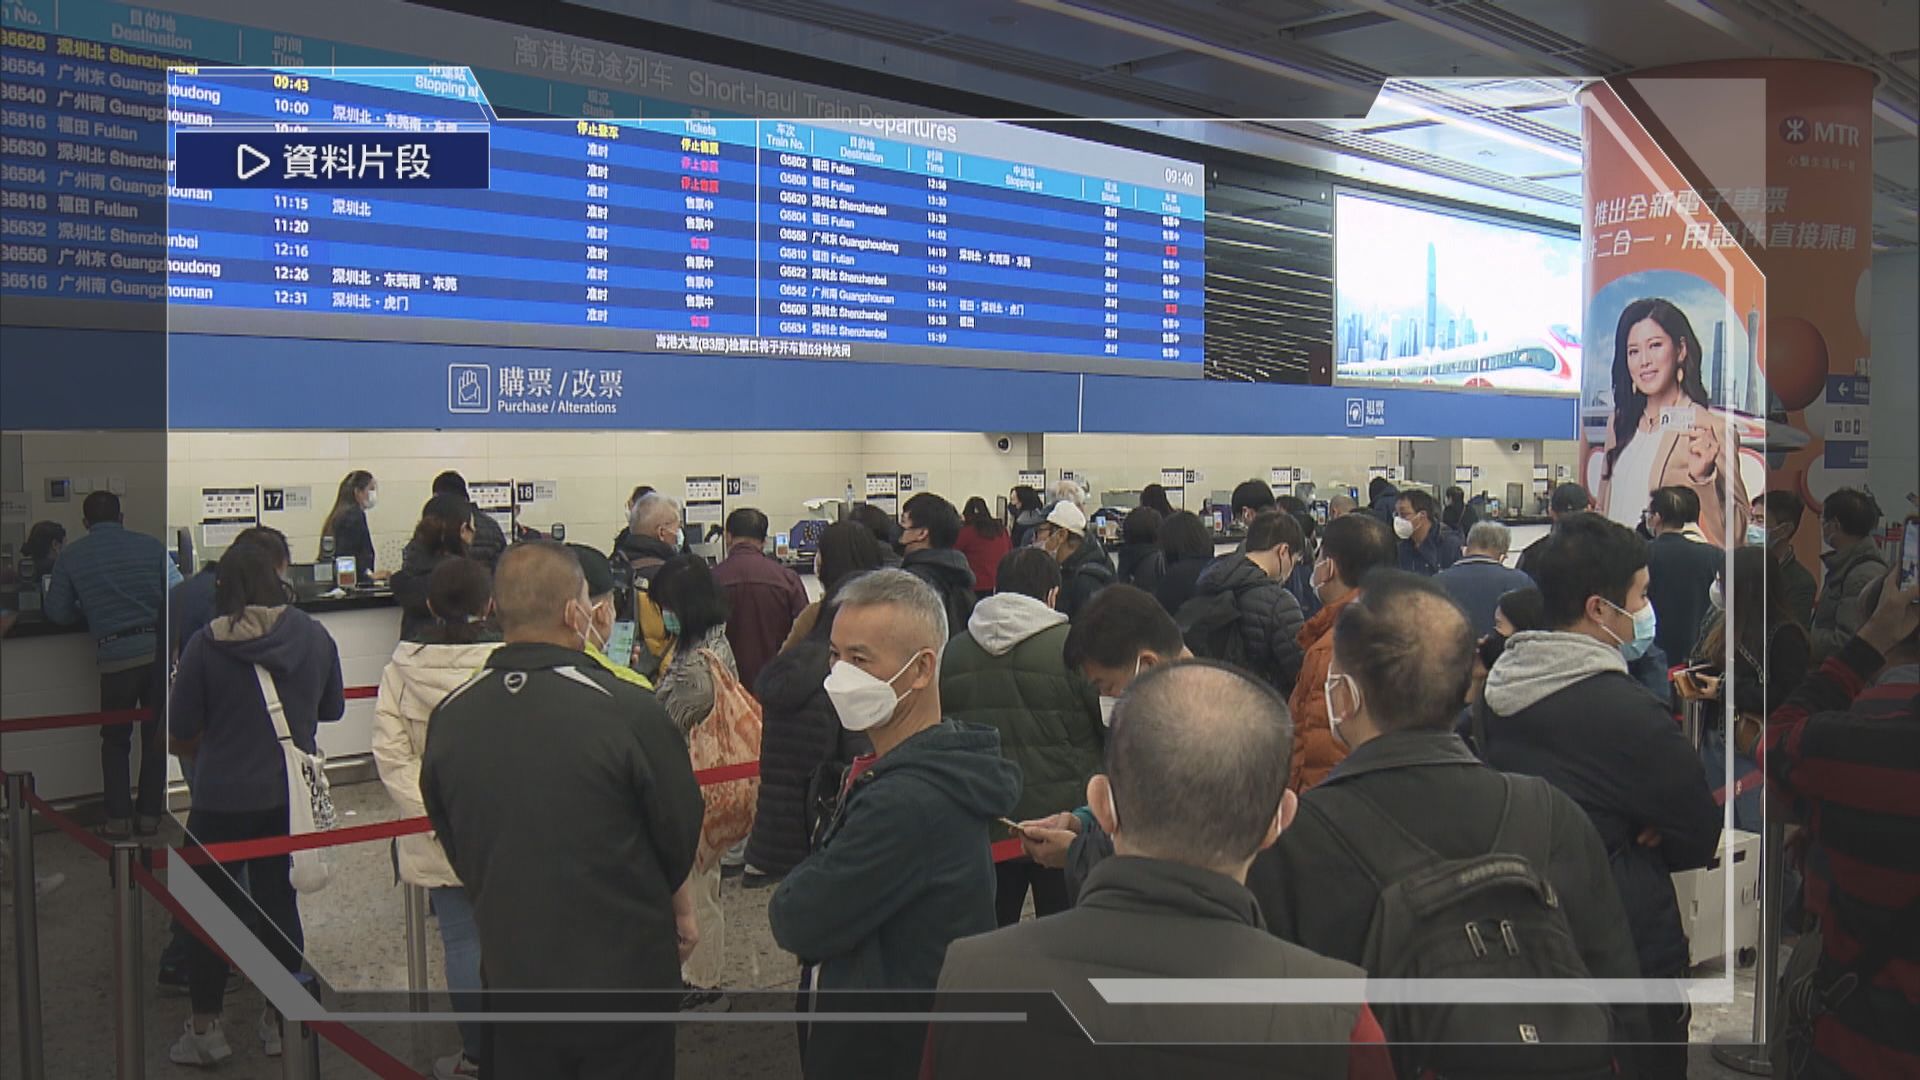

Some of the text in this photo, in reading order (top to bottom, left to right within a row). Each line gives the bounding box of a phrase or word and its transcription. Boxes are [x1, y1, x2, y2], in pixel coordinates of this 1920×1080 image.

[57, 38, 105, 60] 深圳北
[274, 75, 309, 93] 09:43
[57, 64, 106, 86] 广州东
[109, 73, 220, 105] Guangzhoudong
[275, 98, 309, 115] 10:00
[513, 33, 959, 142] 离港短途列车 Short-haul Train Departures
[109, 98, 213, 127] Guangzhounan
[1814, 121, 1859, 148] MTR
[57, 142, 105, 163] 深圳北
[1164, 167, 1194, 187] 09:40
[274, 195, 309, 210] 11:15
[332, 198, 371, 216] 深圳北
[274, 218, 309, 233] 11:20
[58, 222, 105, 241] 深圳北
[110, 228, 198, 249] Shenzhenbei
[274, 243, 309, 257] 12:16
[110, 253, 221, 277] Guangzhoudong
[274, 266, 309, 281] 12:26
[110, 279, 213, 299] Guangzhounan
[274, 290, 308, 305] 12:31
[497, 399, 549, 414] Purchase
[558, 401, 617, 414] Alterations
[518, 484, 533, 500] 18
[728, 480, 740, 494] 19
[900, 477, 912, 488] 20
[265, 493, 282, 508] 17
